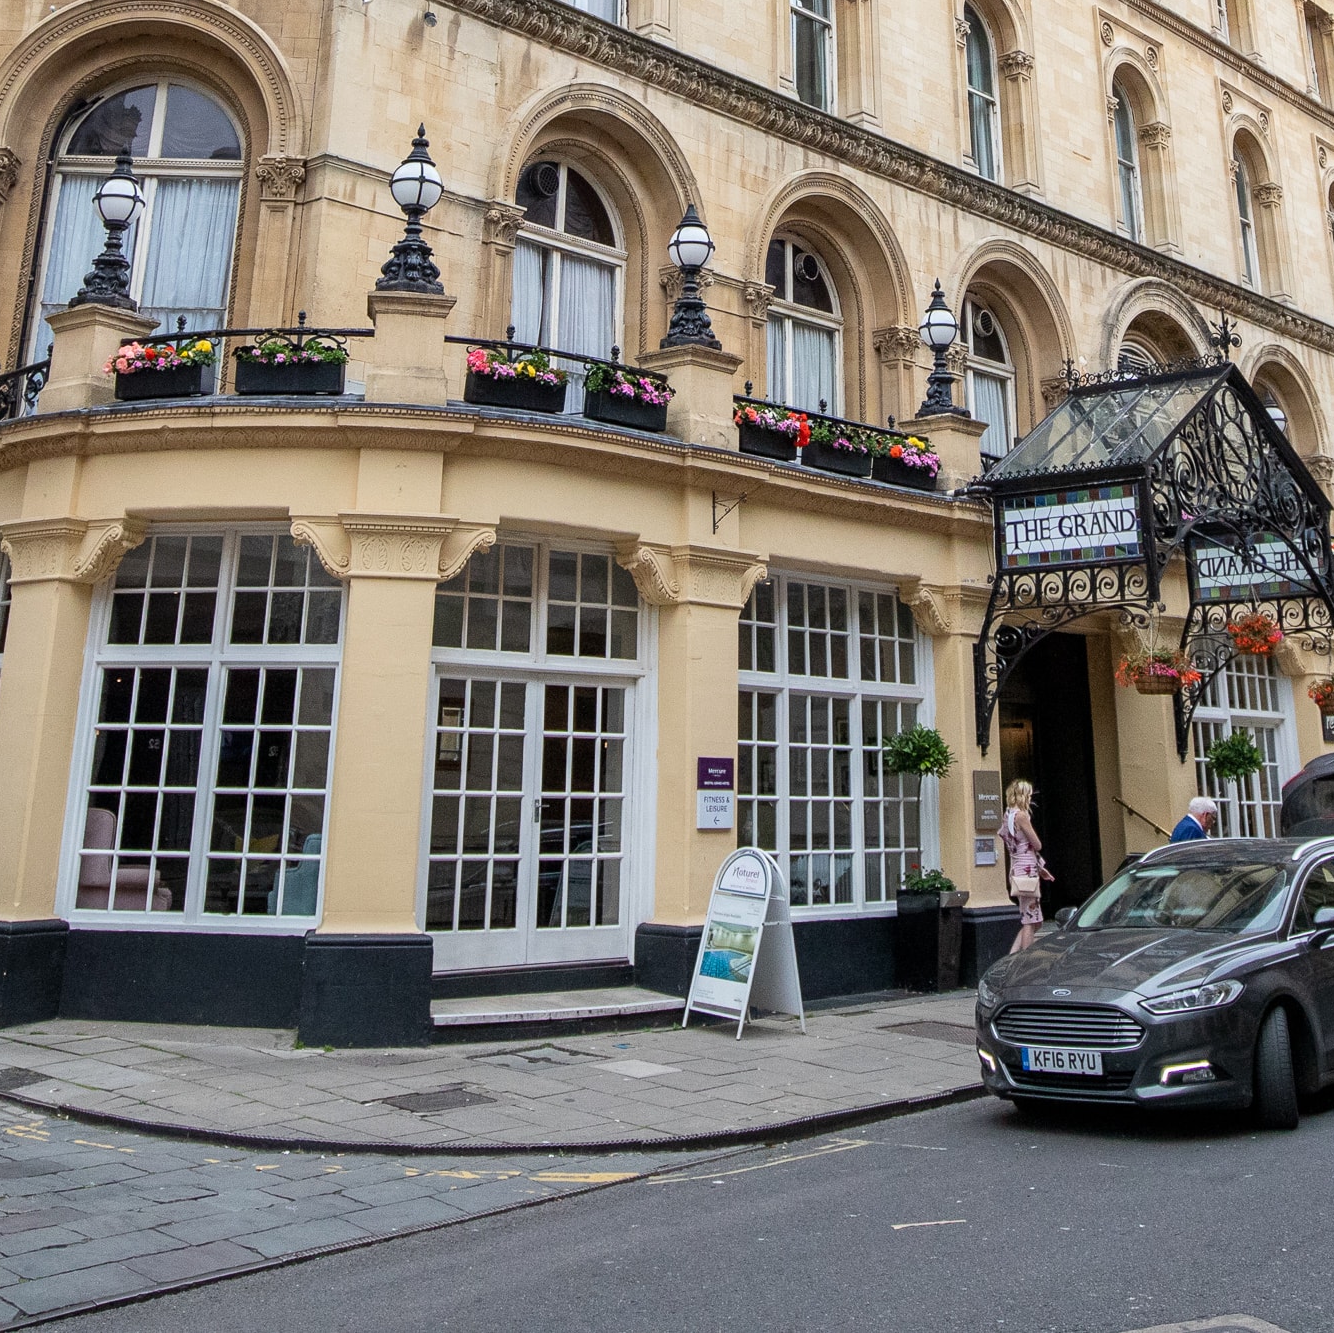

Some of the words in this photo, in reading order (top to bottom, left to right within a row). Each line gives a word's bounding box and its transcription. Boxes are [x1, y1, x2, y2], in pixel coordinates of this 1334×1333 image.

[1005, 518, 1050, 551] THE
[1057, 509, 1137, 539] GRAND
[703, 796, 725, 804] FITNESS
[726, 796, 730, 804] &
[706, 805, 728, 813] LEISURE
[1033, 1050, 1065, 1068] KF16
[1068, 1052, 1096, 1070] RYU
